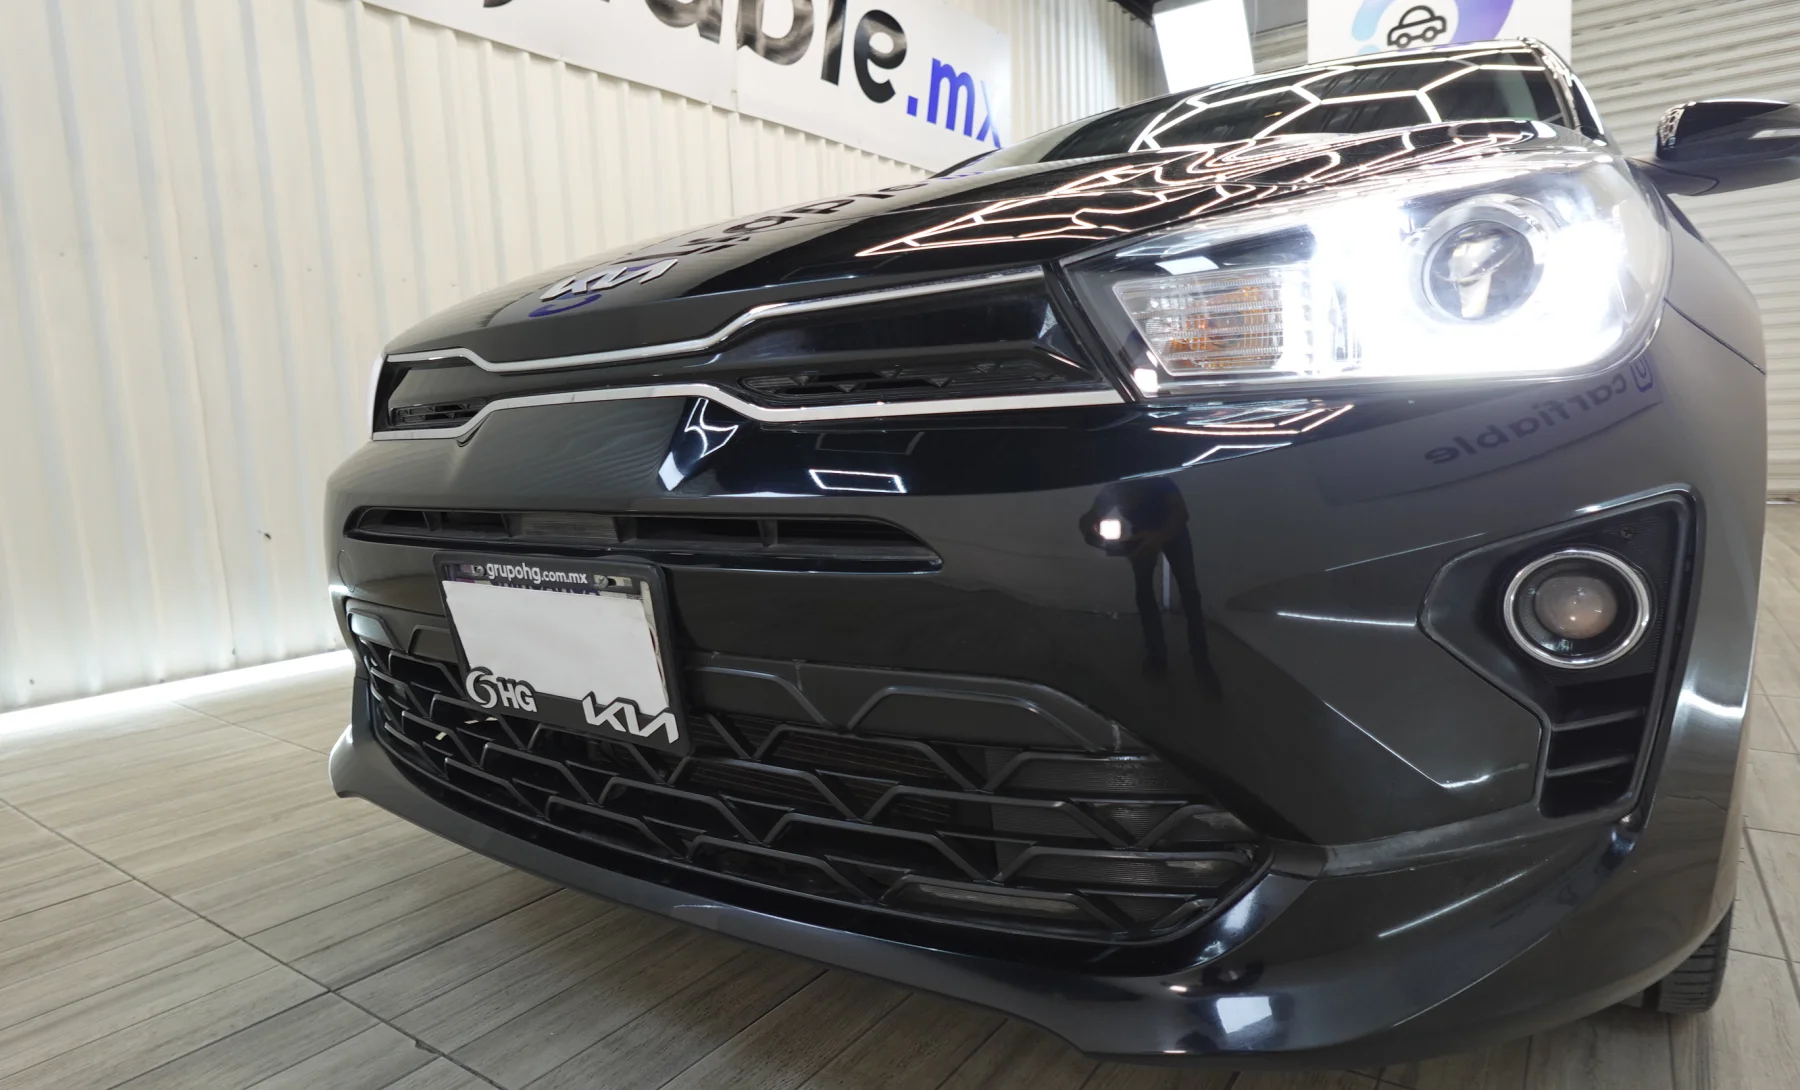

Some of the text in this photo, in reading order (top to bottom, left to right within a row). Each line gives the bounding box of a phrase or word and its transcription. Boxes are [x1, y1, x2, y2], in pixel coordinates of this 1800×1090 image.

[541, 258, 679, 303] KIA
[486, 562, 589, 585] grupohg.com.mx
[497, 681, 538, 713] HG
[581, 695, 680, 744] KIA
